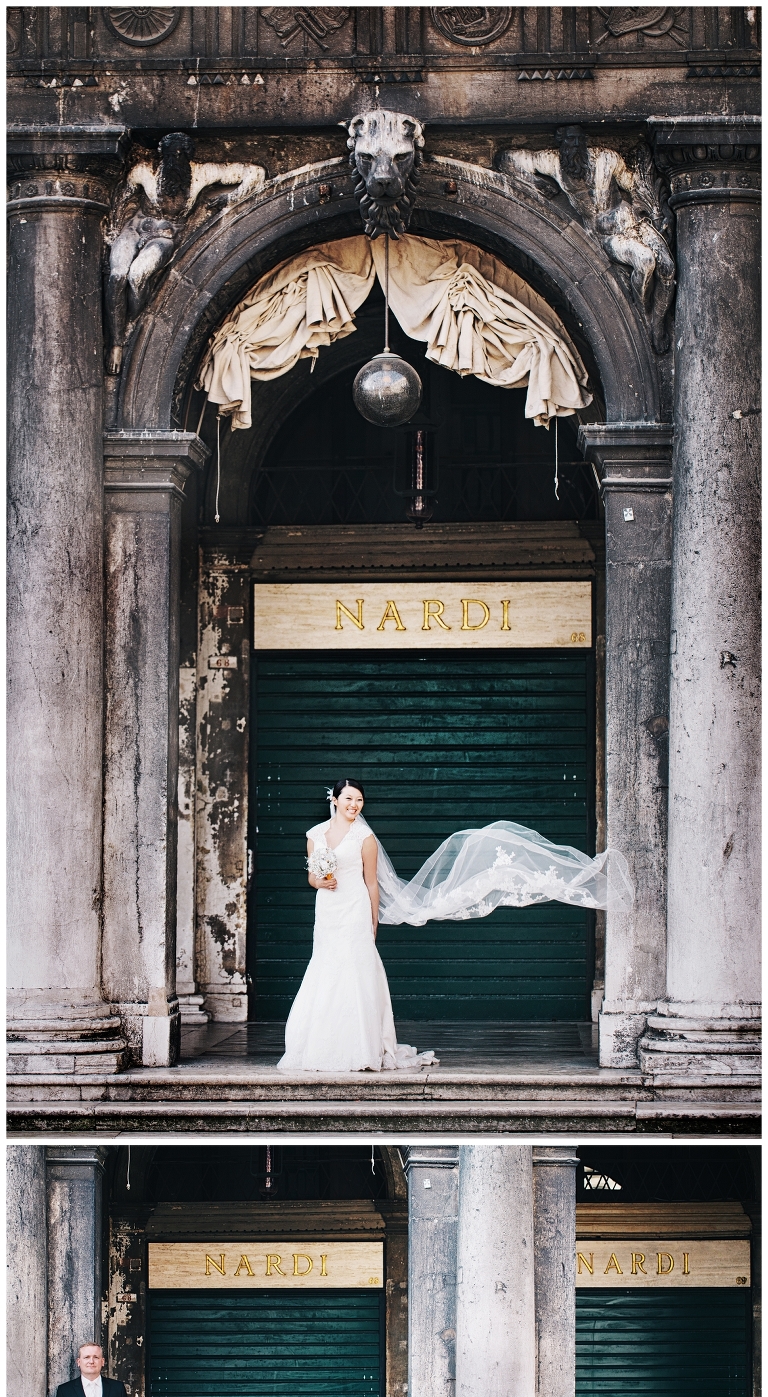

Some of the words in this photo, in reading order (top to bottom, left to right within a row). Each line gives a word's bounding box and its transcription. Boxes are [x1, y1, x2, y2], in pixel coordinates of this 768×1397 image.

[335, 599, 511, 631] NARDI
[571, 632, 586, 642] 68
[216, 659, 230, 667] 68
[204, 1253, 328, 1277] NARDI
[577, 1252, 690, 1275] NARDI
